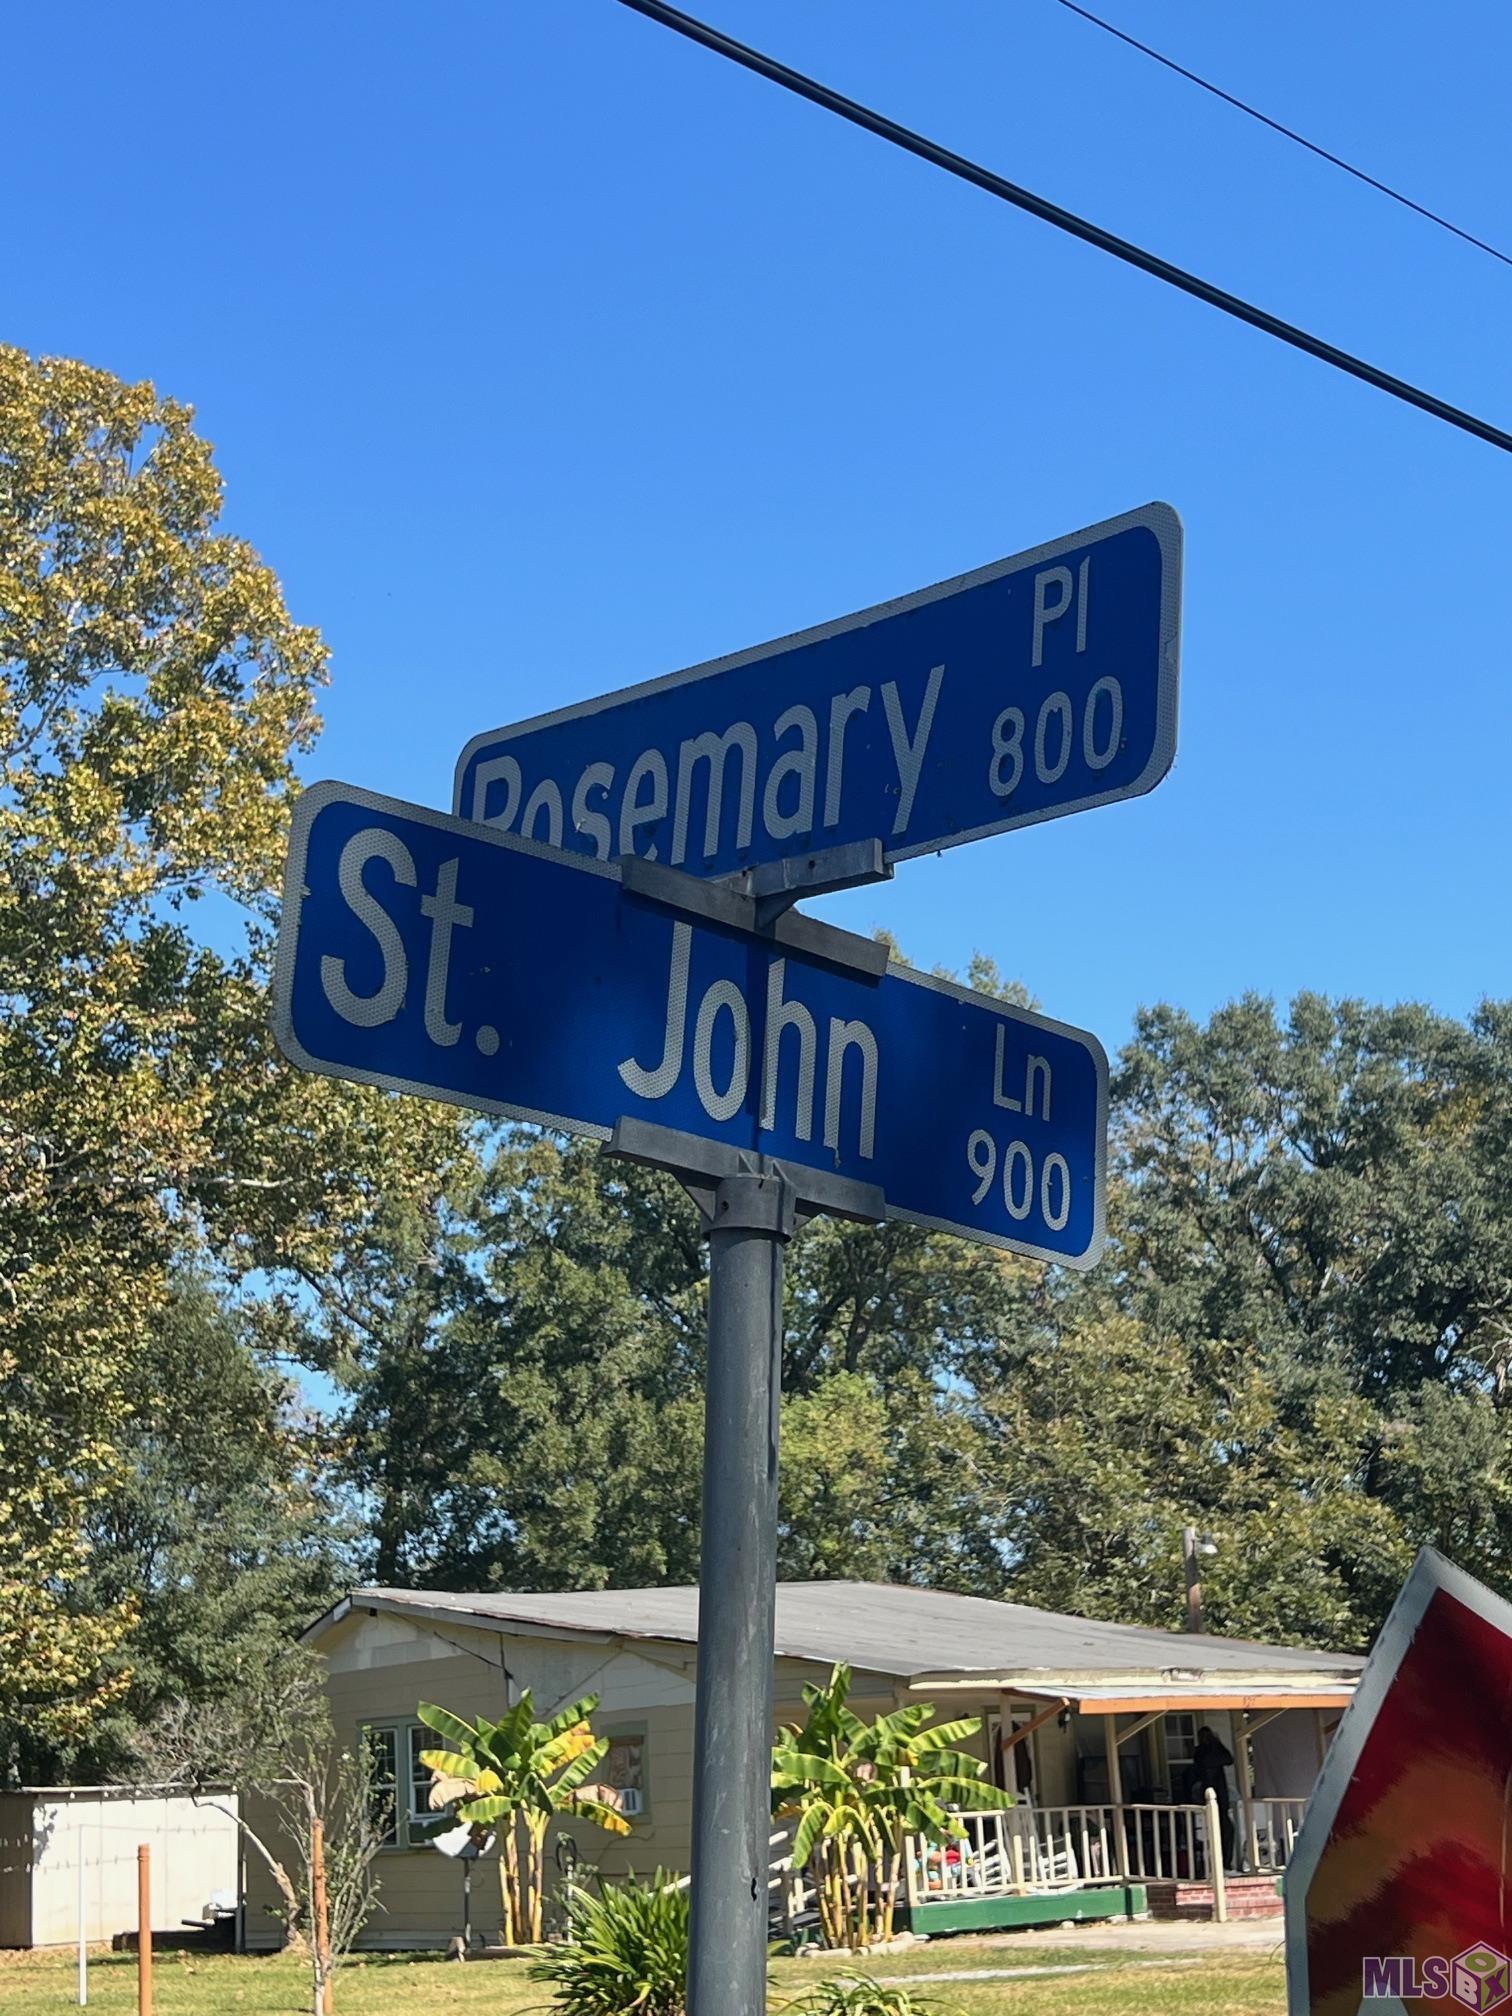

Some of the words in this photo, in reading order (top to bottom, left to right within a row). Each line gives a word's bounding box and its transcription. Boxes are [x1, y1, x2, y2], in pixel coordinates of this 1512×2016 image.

[1031, 555, 1091, 668] Pl
[988, 675, 1124, 798] 800
[320, 828, 501, 1057] St.
[617, 919, 879, 1162] John
[993, 1023, 1052, 1122] Ln
[966, 1128, 1071, 1232] 900
